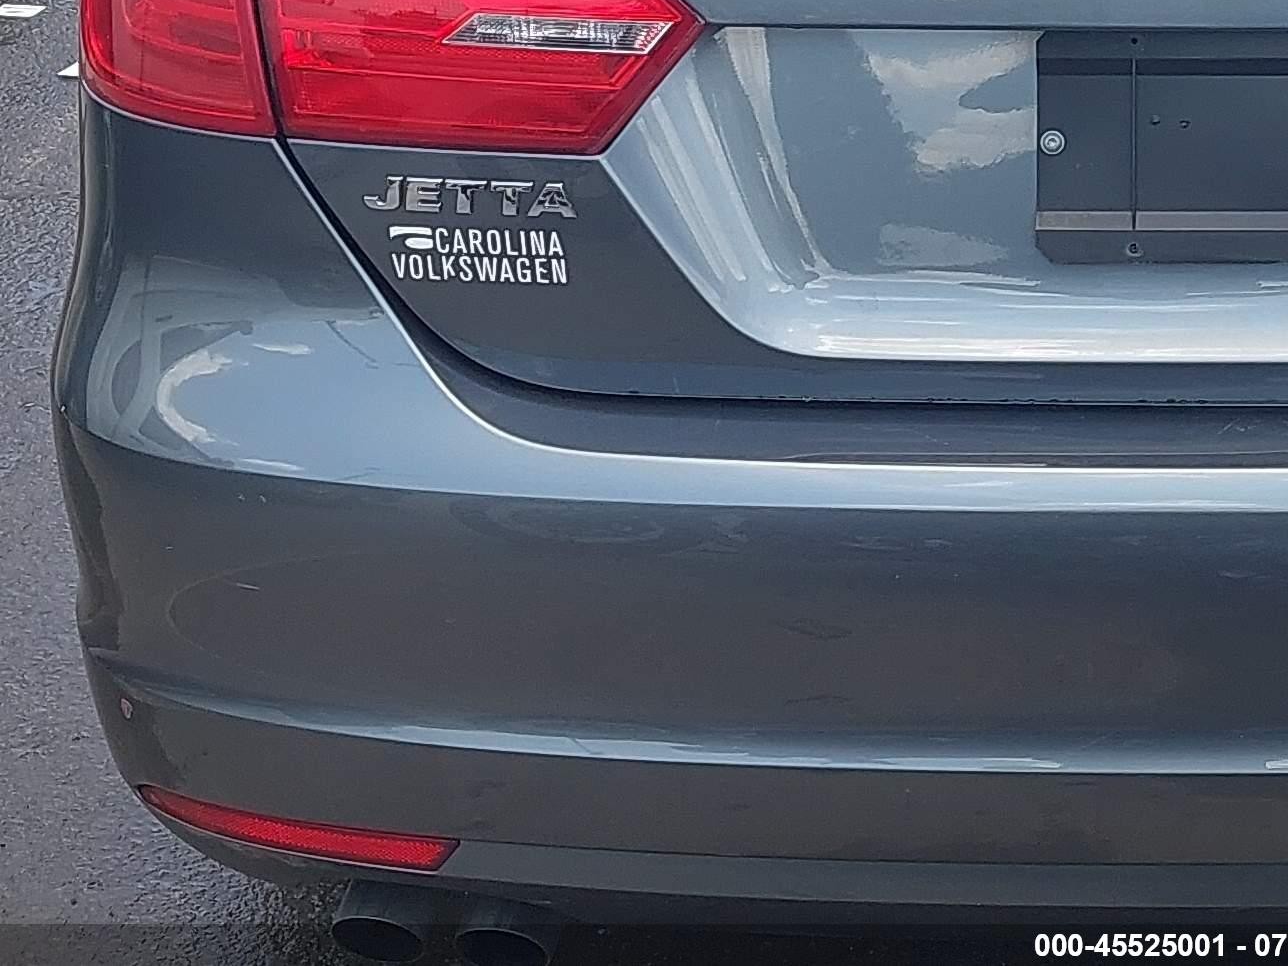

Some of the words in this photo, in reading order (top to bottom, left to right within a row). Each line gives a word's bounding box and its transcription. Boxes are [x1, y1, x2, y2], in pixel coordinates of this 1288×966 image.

[362, 176, 578, 219] JETTA
[435, 228, 564, 256] CAROLINA
[391, 253, 568, 284] VOLKSWAGEN
